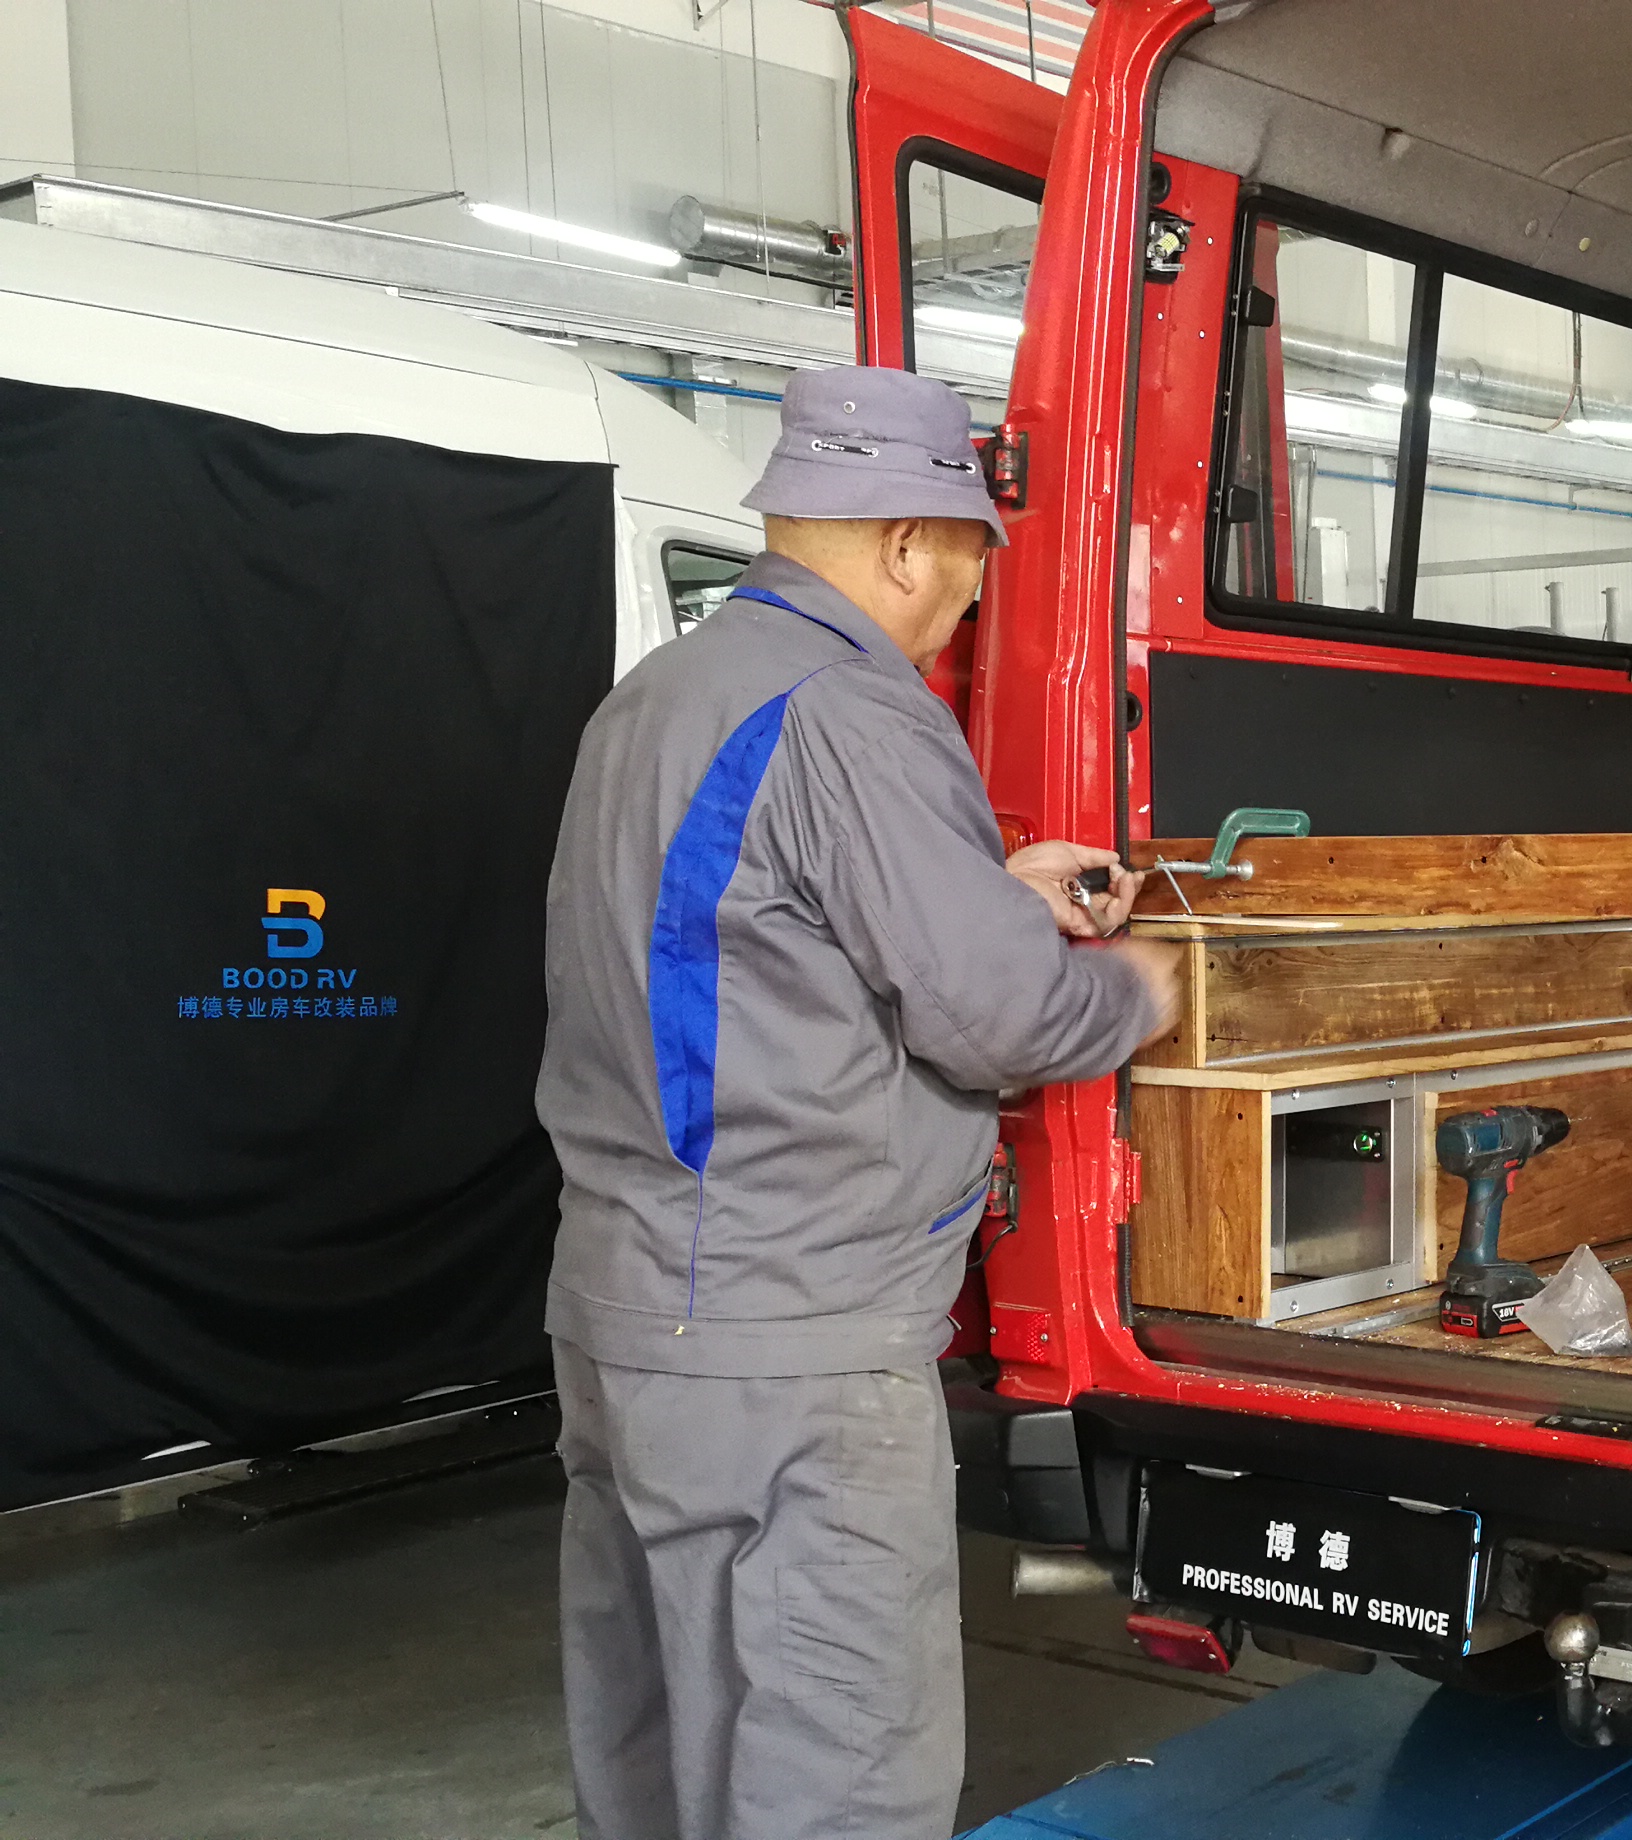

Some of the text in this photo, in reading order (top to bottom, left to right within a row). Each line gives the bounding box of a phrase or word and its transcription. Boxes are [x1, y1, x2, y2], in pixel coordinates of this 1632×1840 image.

[222, 967, 357, 989] BOOD RV
[177, 995, 398, 1019] 博德专业房车改装品牌
[1499, 1306, 1515, 1318] 18V
[1182, 1564, 1450, 1636] PROFESSIONAL RV SERVICE
